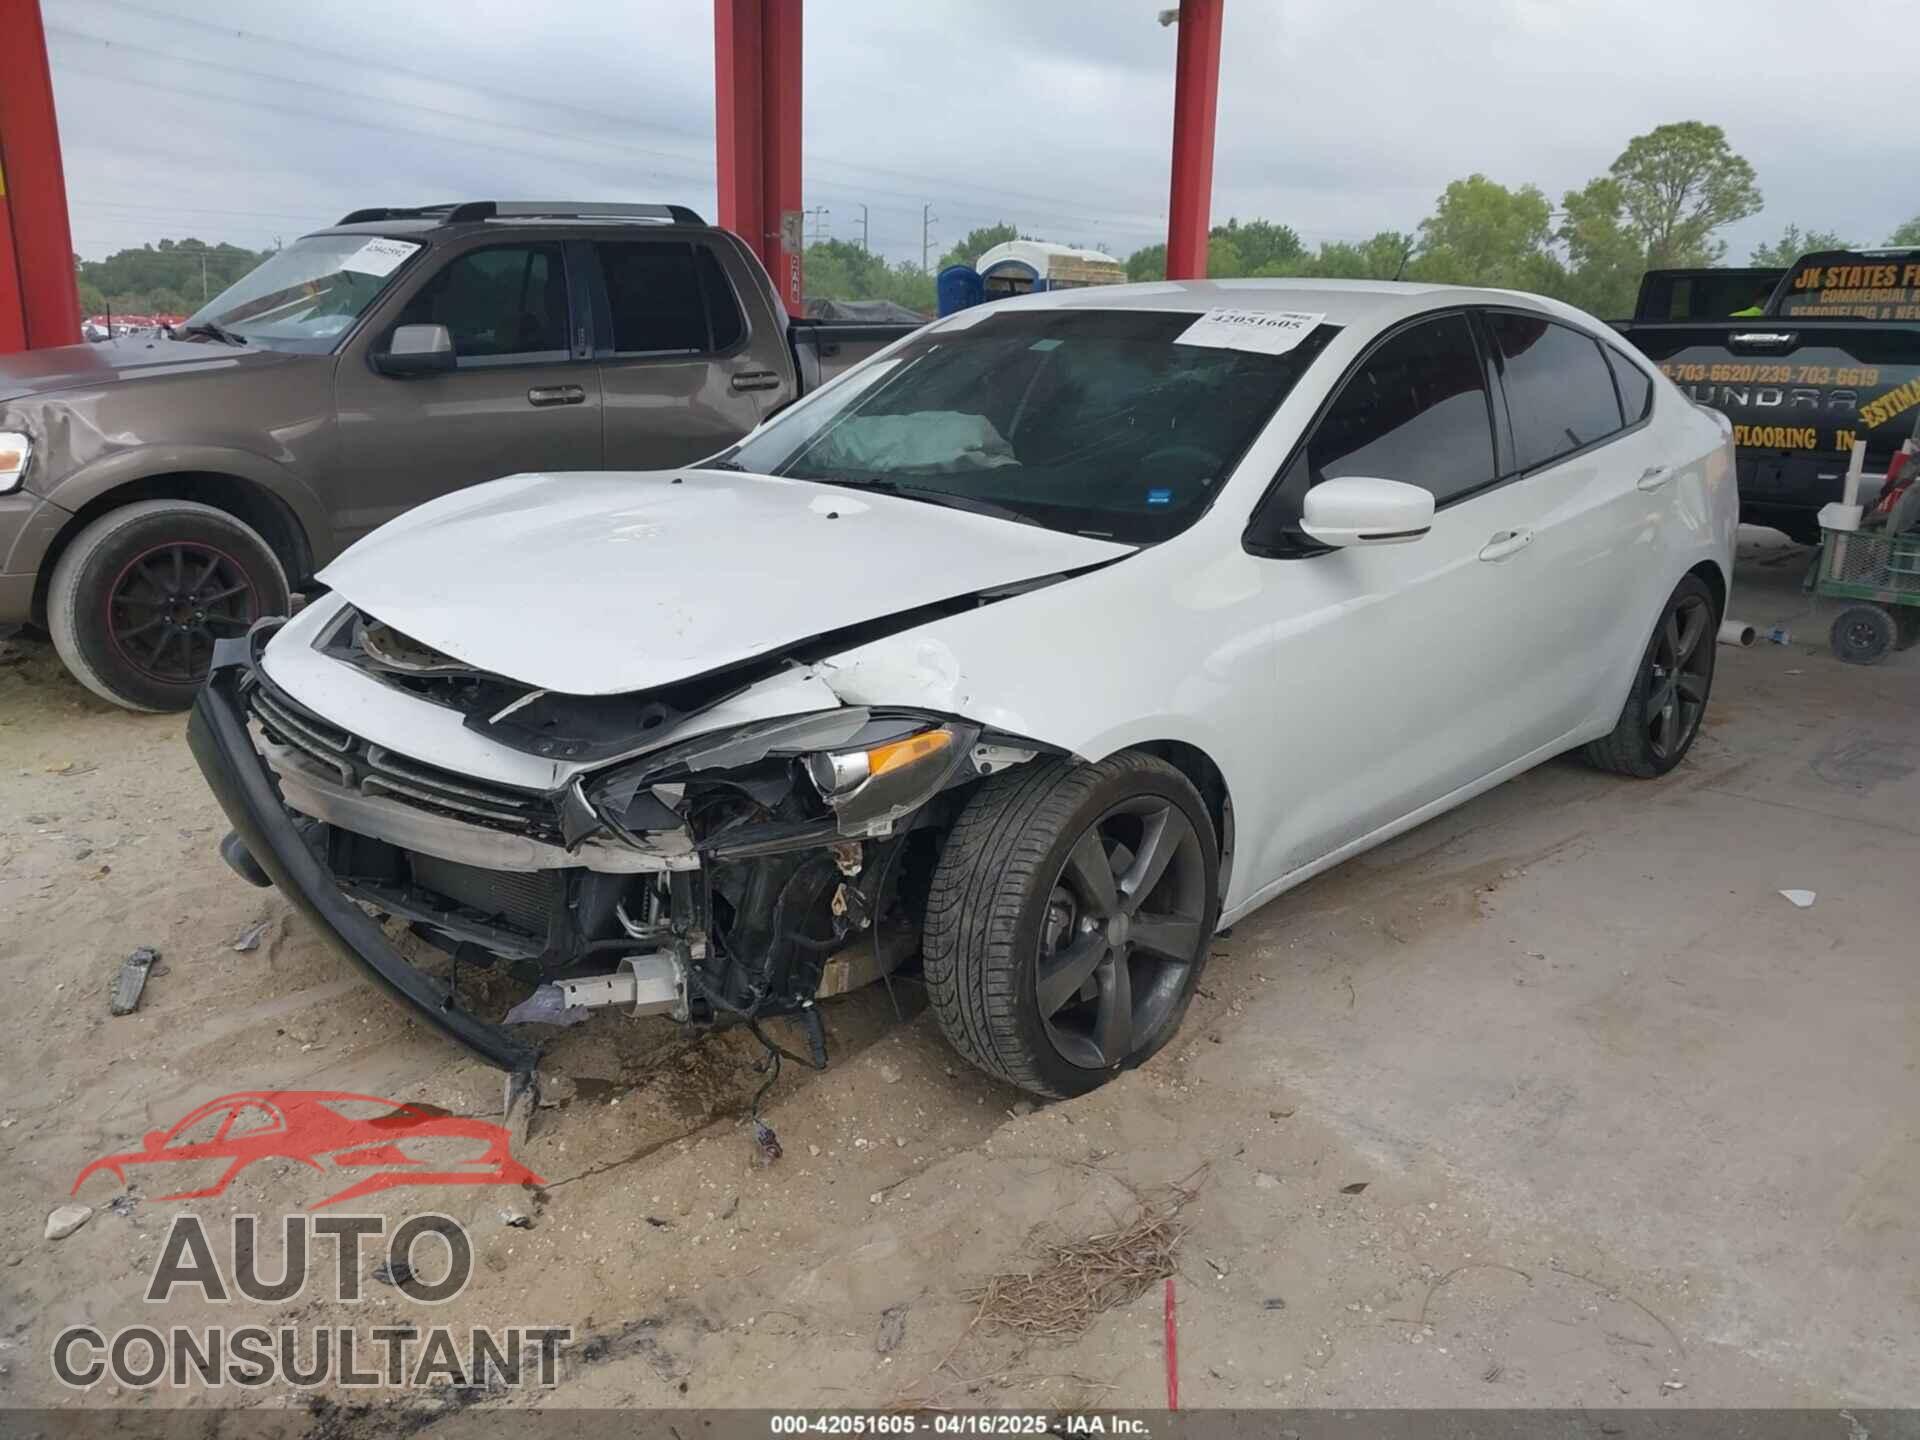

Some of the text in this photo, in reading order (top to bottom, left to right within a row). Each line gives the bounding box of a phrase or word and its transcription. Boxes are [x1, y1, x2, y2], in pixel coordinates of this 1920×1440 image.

[1825, 264, 1898, 288] STATES
[1211, 314, 1304, 330] 42051605
[1680, 384, 1858, 409] UNDRA
[1734, 425, 1817, 450] FLOORING
